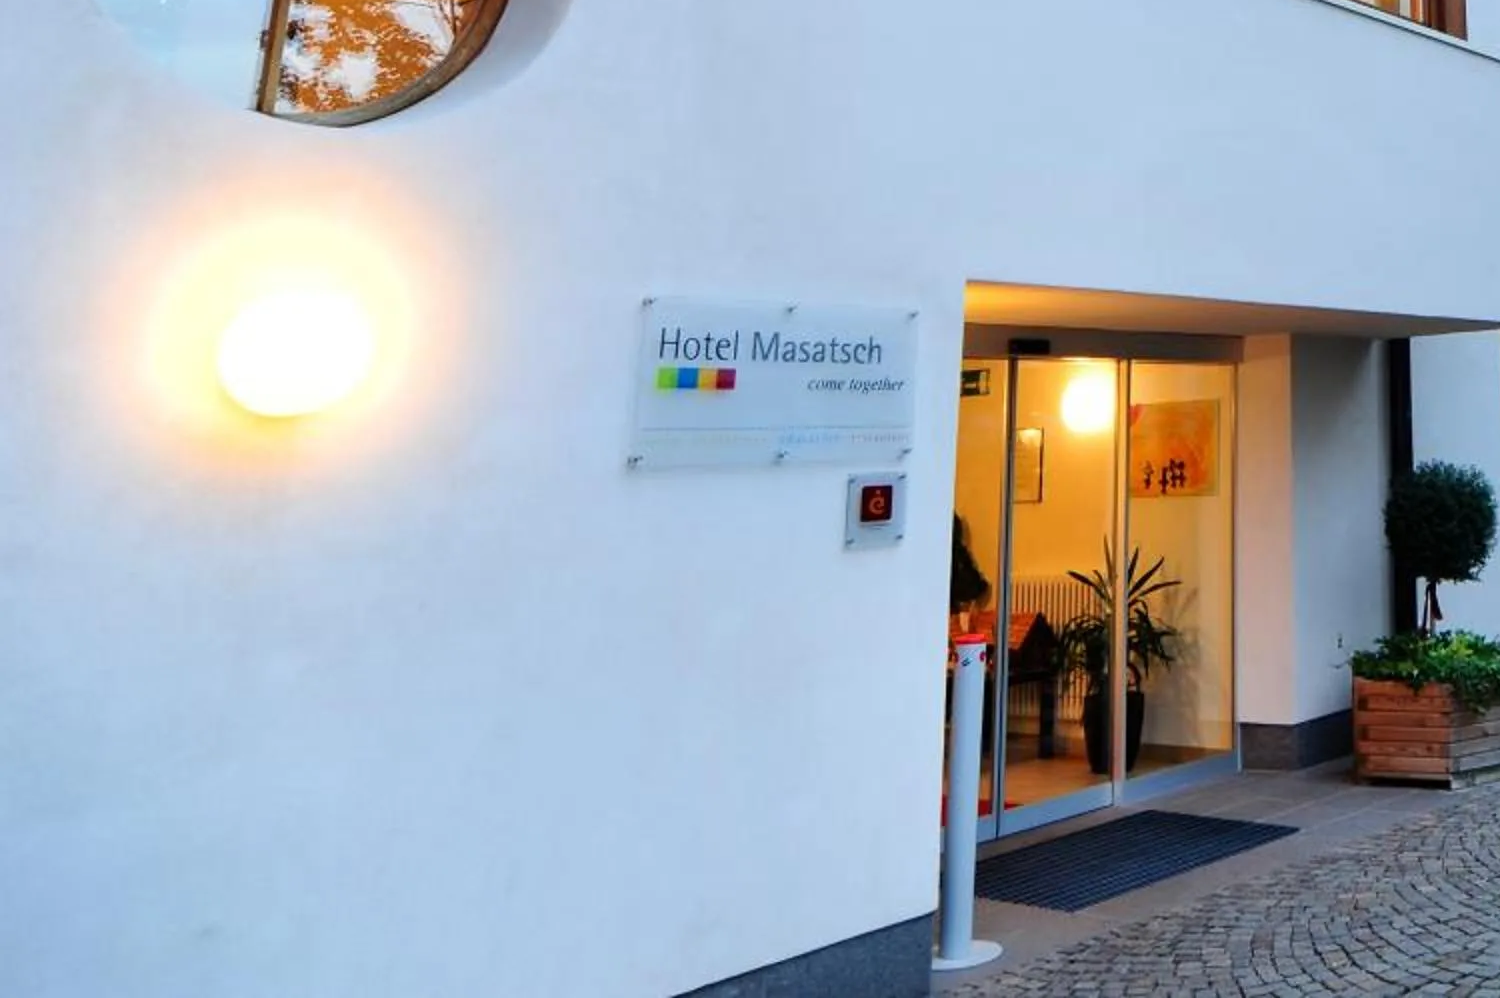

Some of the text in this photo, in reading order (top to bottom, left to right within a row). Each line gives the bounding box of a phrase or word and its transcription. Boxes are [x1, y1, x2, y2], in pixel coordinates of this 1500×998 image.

[658, 327, 882, 365] Hotel Masatsch
[807, 377, 905, 394] come together
